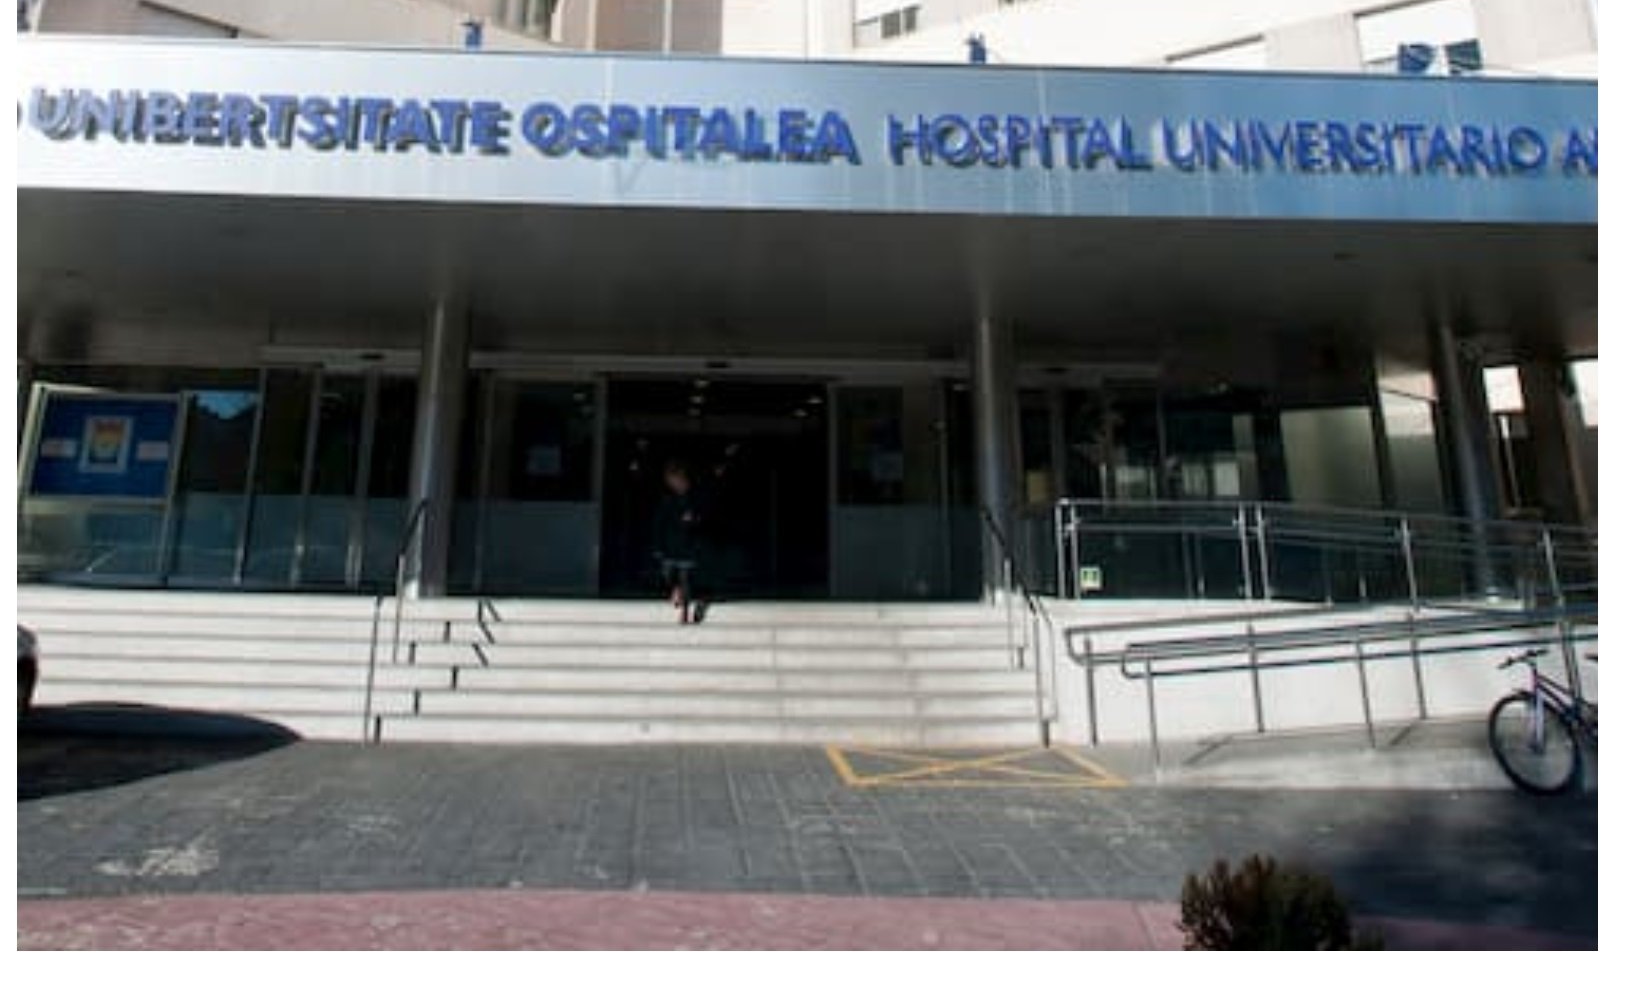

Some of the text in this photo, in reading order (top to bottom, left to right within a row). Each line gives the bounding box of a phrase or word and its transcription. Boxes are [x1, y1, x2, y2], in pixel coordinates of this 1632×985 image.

[29, 88, 511, 153] UNIBERTSITATE
[521, 101, 861, 165] OSPITALEA
[887, 114, 1153, 171] HOSPITAL
[1163, 119, 1549, 176] UNIVERSITARIO
